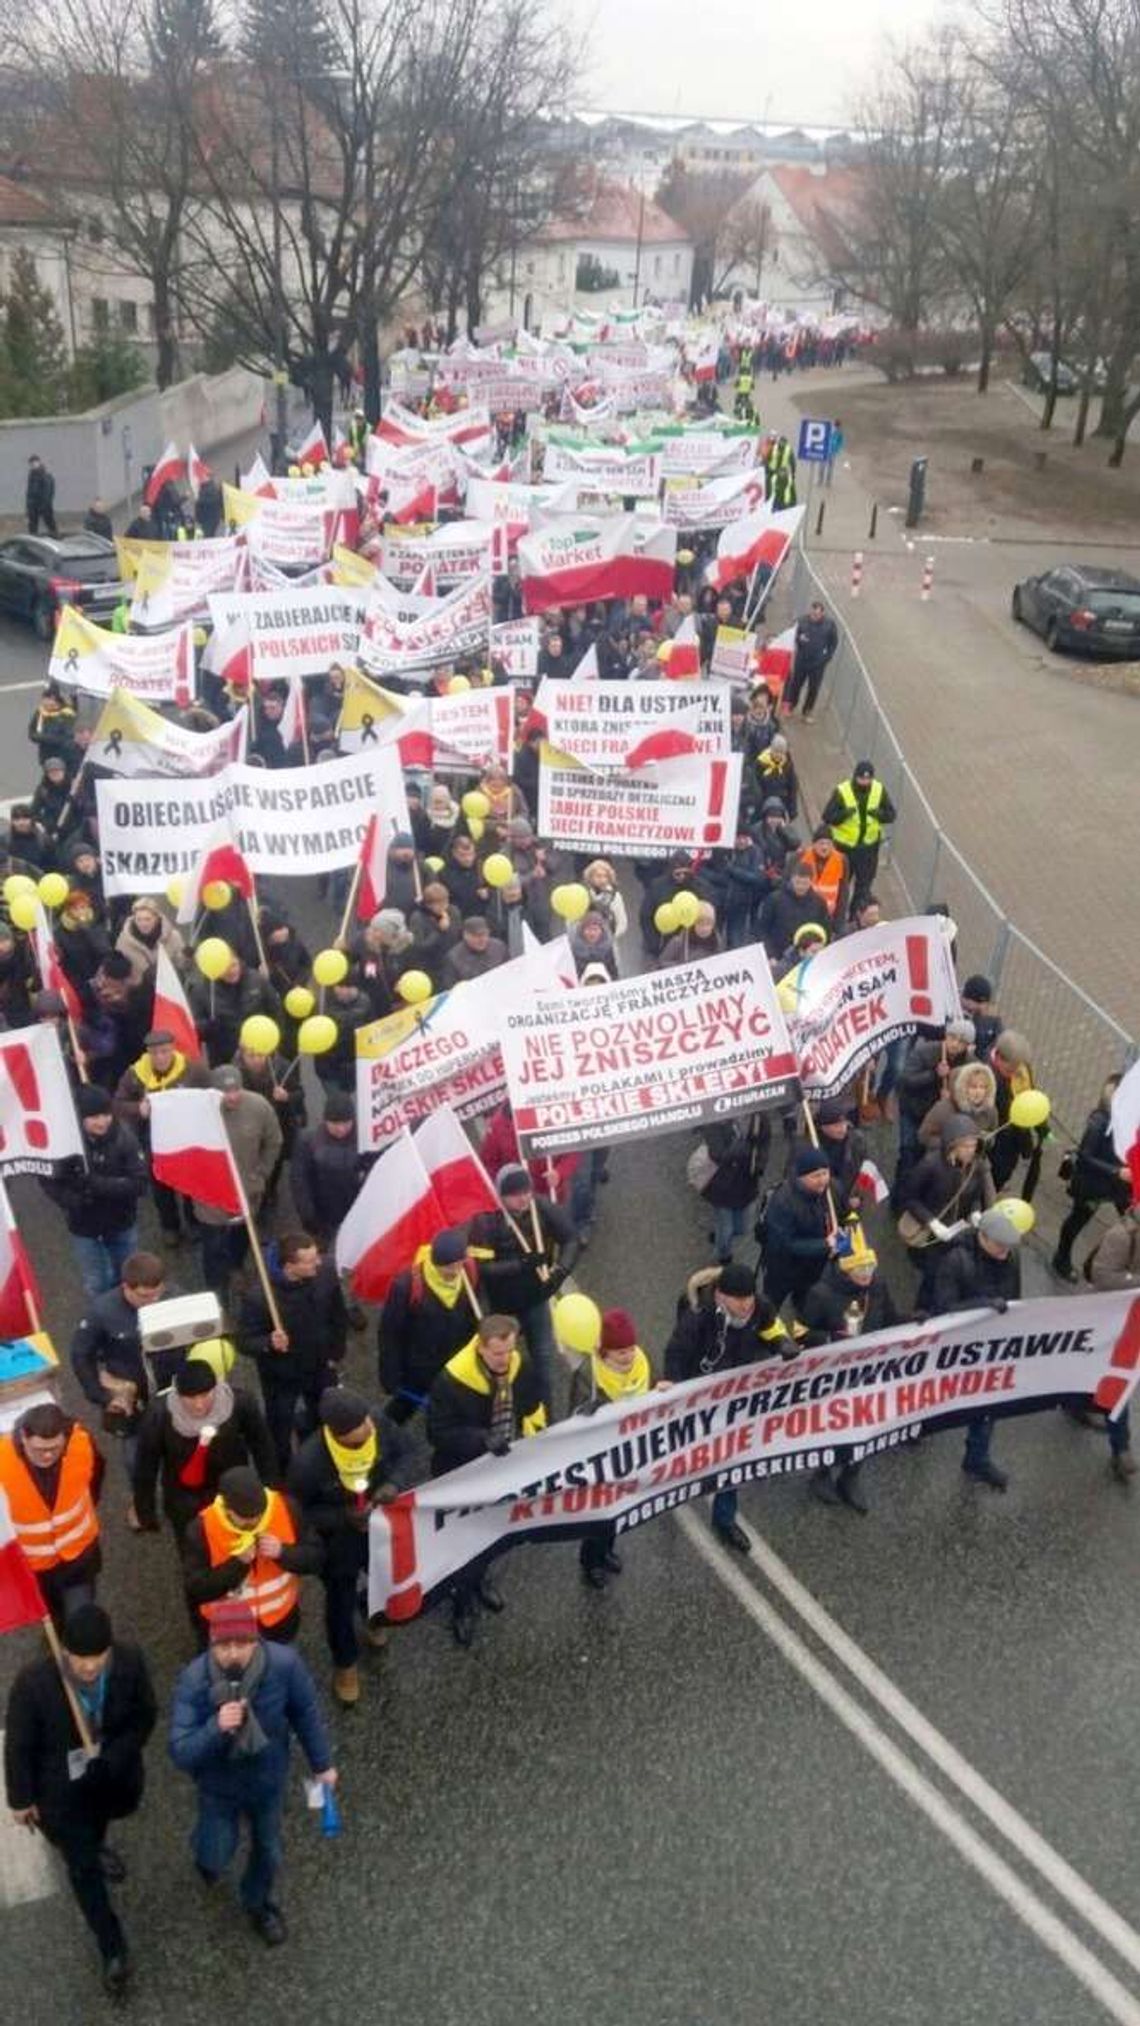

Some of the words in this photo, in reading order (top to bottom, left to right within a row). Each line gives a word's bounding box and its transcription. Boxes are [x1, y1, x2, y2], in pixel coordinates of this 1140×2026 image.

[806, 423, 825, 448] P
[400, 557, 481, 574] POATEK
[255, 604, 351, 630] ZABIERAJCIE
[259, 634, 341, 660] POLSKICH
[599, 694, 634, 713] DLA
[256, 773, 377, 812] WSPARCIE
[599, 804, 660, 822] POLSKIE
[524, 1033, 562, 1059] NIE
[571, 993, 747, 1051] POZWOLIMY
[519, 1059, 564, 1086] JEJ
[577, 1005, 772, 1077] ZNISZCZYĆ
[452, 1056, 506, 1096] SKLE
[580, 1070, 663, 1097] POLAKAMI
[679, 1044, 774, 1081] prowadzimy
[536, 1090, 641, 1128] POLSKIE
[2, 1160, 53, 1177] ANDLU
[727, 1348, 928, 1427] PRZECIWKO
[936, 1328, 1095, 1367] USTAWIE,
[650, 1423, 755, 1486] ZABIJE
[761, 1389, 888, 1445] POLSKI
[895, 1364, 1017, 1415] HANDEL
[716, 1449, 836, 1489] POLSKIEGO
